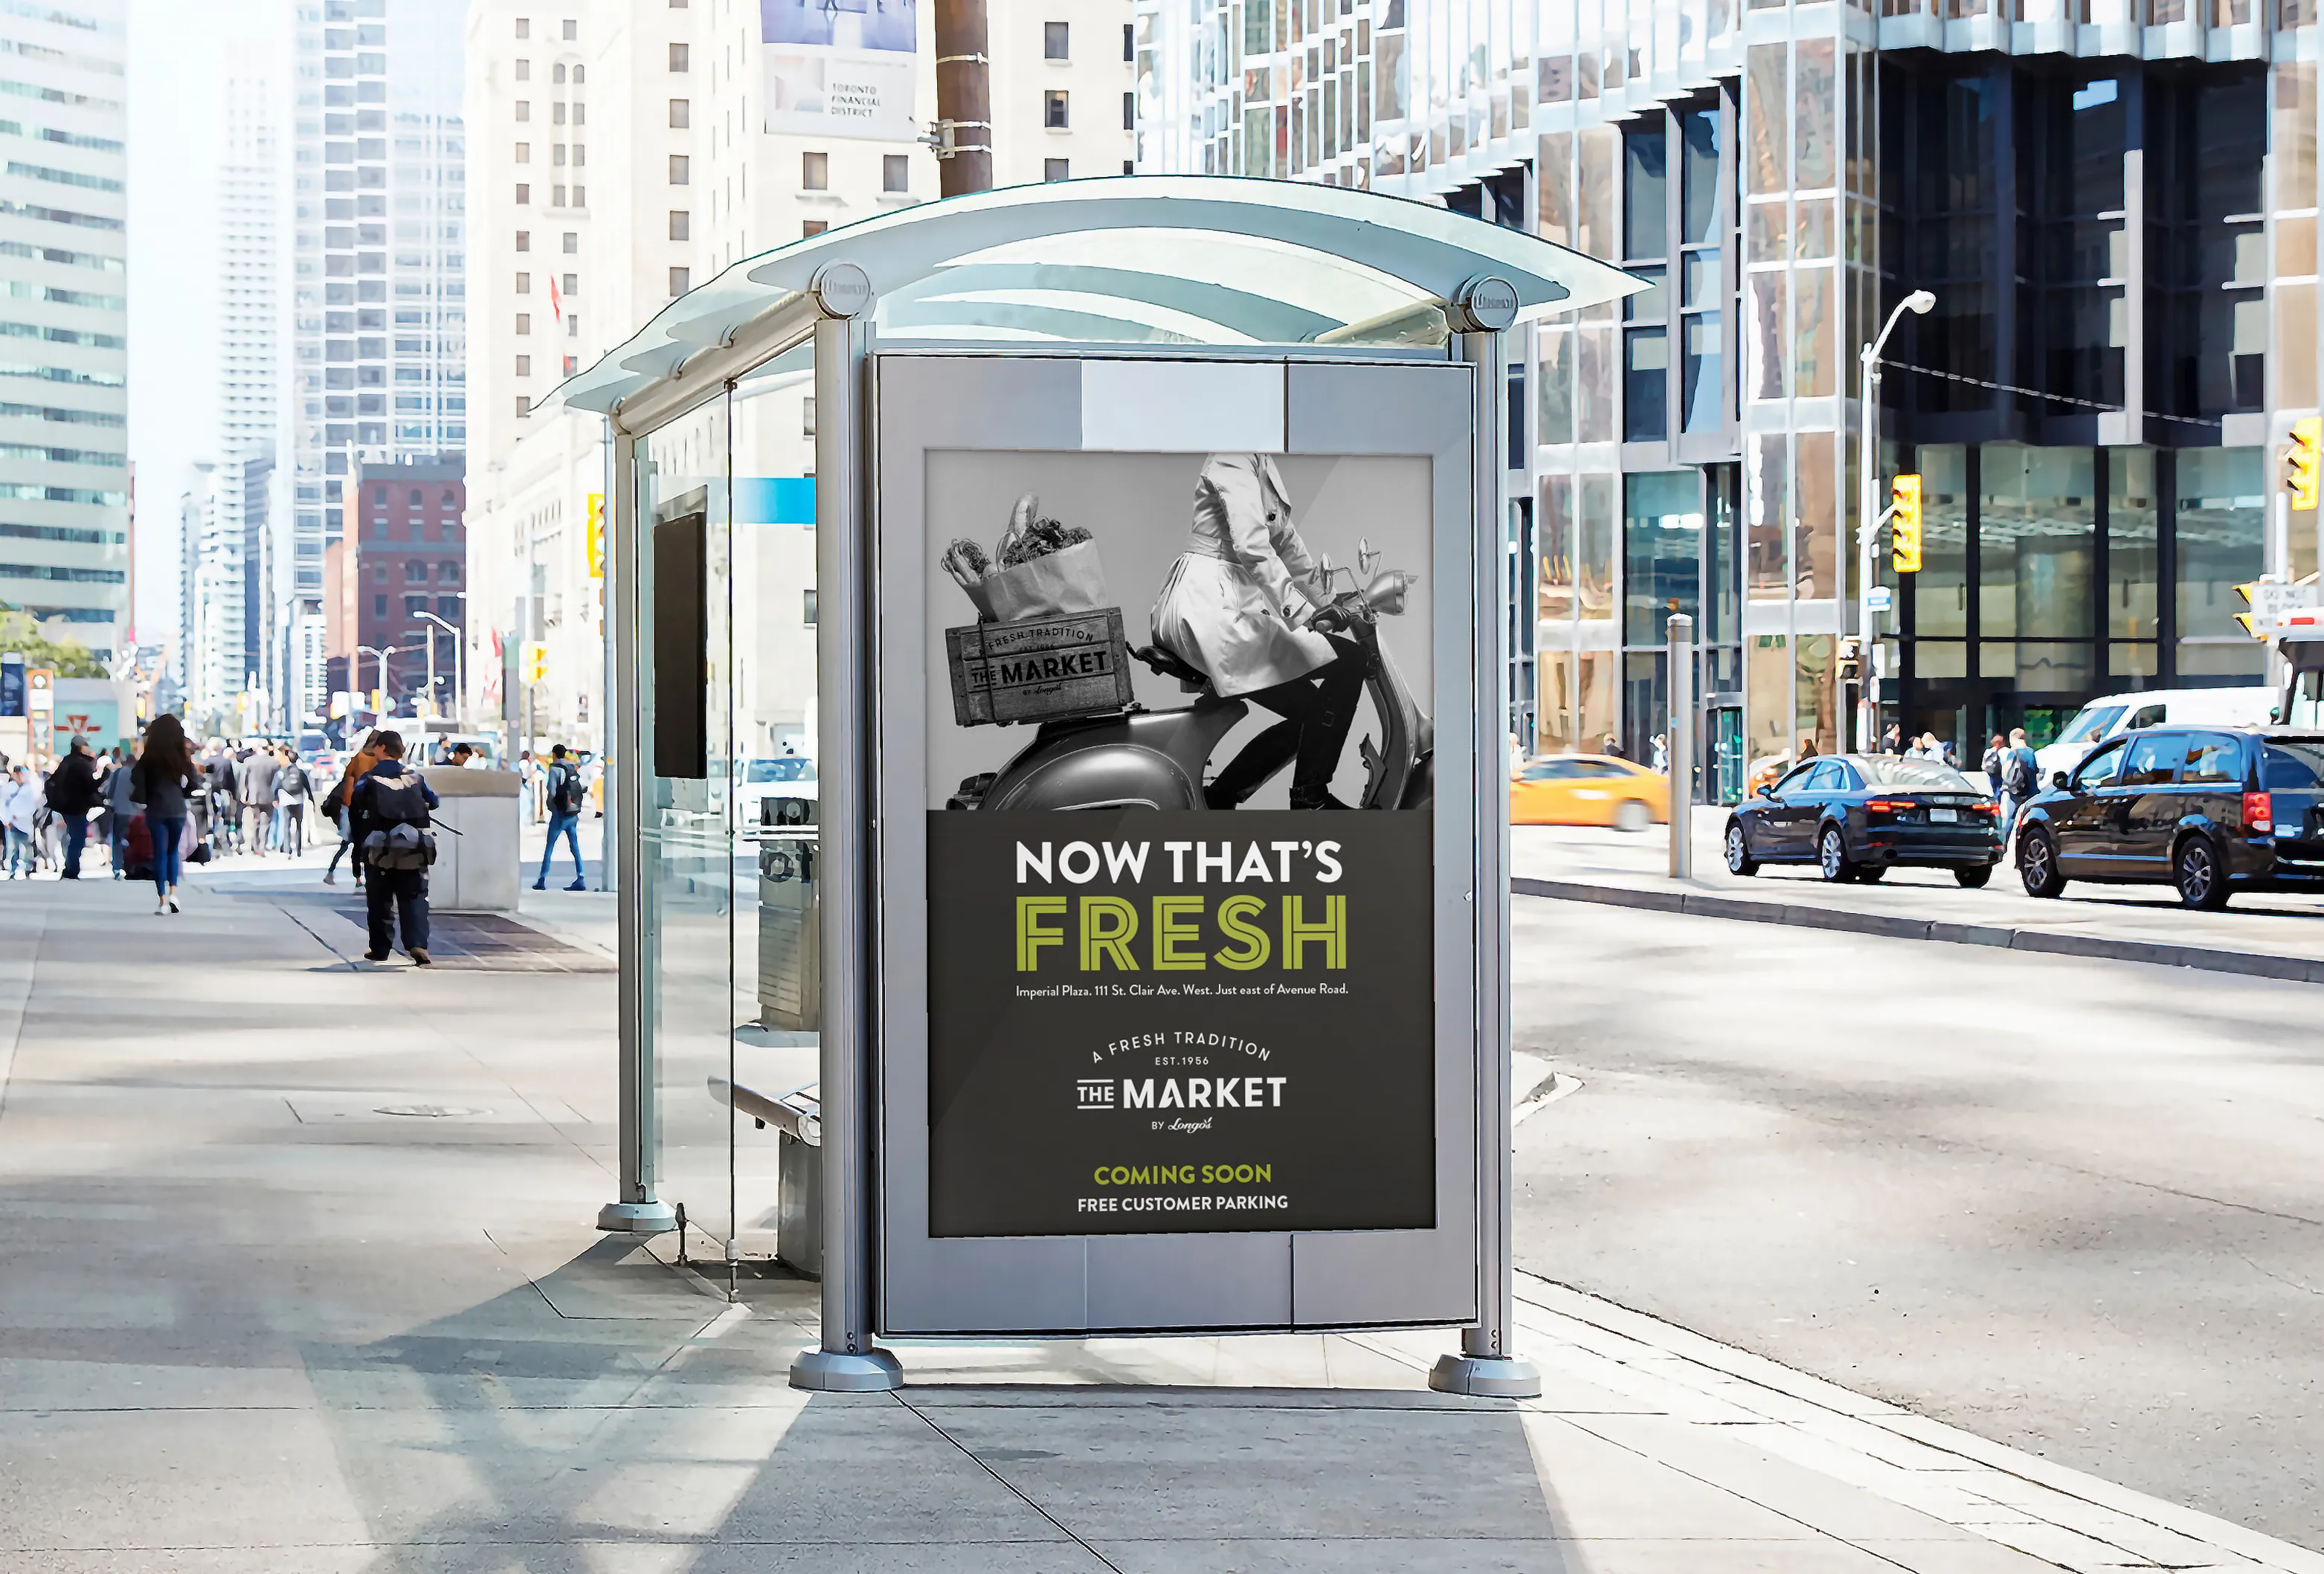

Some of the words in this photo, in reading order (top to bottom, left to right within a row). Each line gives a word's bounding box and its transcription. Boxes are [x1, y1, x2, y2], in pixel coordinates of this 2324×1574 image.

[832, 83, 877, 95] TORONTO
[831, 94, 881, 107] FINANCIAL
[831, 106, 872, 117] DISTRICT
[988, 630, 1026, 651] FRESH
[1029, 627, 1094, 642] TRADITION
[971, 670, 997, 683] THE
[1000, 650, 1107, 684] MARKET
[1016, 840, 1151, 884] NOW
[1164, 840, 1343, 883] THAT'S
[1016, 894, 1347, 972] FRESH
[1016, 984, 1059, 1001] Imperial
[1062, 984, 1092, 996] Plaza.
[1094, 985, 1108, 996] 111
[1111, 984, 1127, 996] St.
[1129, 984, 1155, 996] Clair
[1156, 984, 1181, 996] Ave.
[1182, 984, 1213, 996] West.
[1214, 983, 1237, 996] Just
[1239, 986, 1261, 995] east
[1264, 983, 1275, 995] of
[1276, 983, 1317, 995] Avenue
[1319, 982, 1349, 994] Road.
[1092, 1051, 1103, 1064] A
[1108, 1031, 1165, 1056] FRESH
[1174, 1031, 1271, 1062] TRADITION
[1155, 1056, 1209, 1066] EST.1956
[1076, 1086, 1115, 1103] THE
[1123, 1077, 1287, 1109] MARKET
[1151, 1121, 1165, 1130] BY
[1167, 1116, 1213, 1134] Longo's
[1094, 1165, 1195, 1185] COMING
[1201, 1164, 1271, 1184] SOON
[1078, 1198, 1118, 1213] FREE
[1121, 1196, 1212, 1212] CUSTOMER
[1216, 1195, 1288, 1210] PARKING
